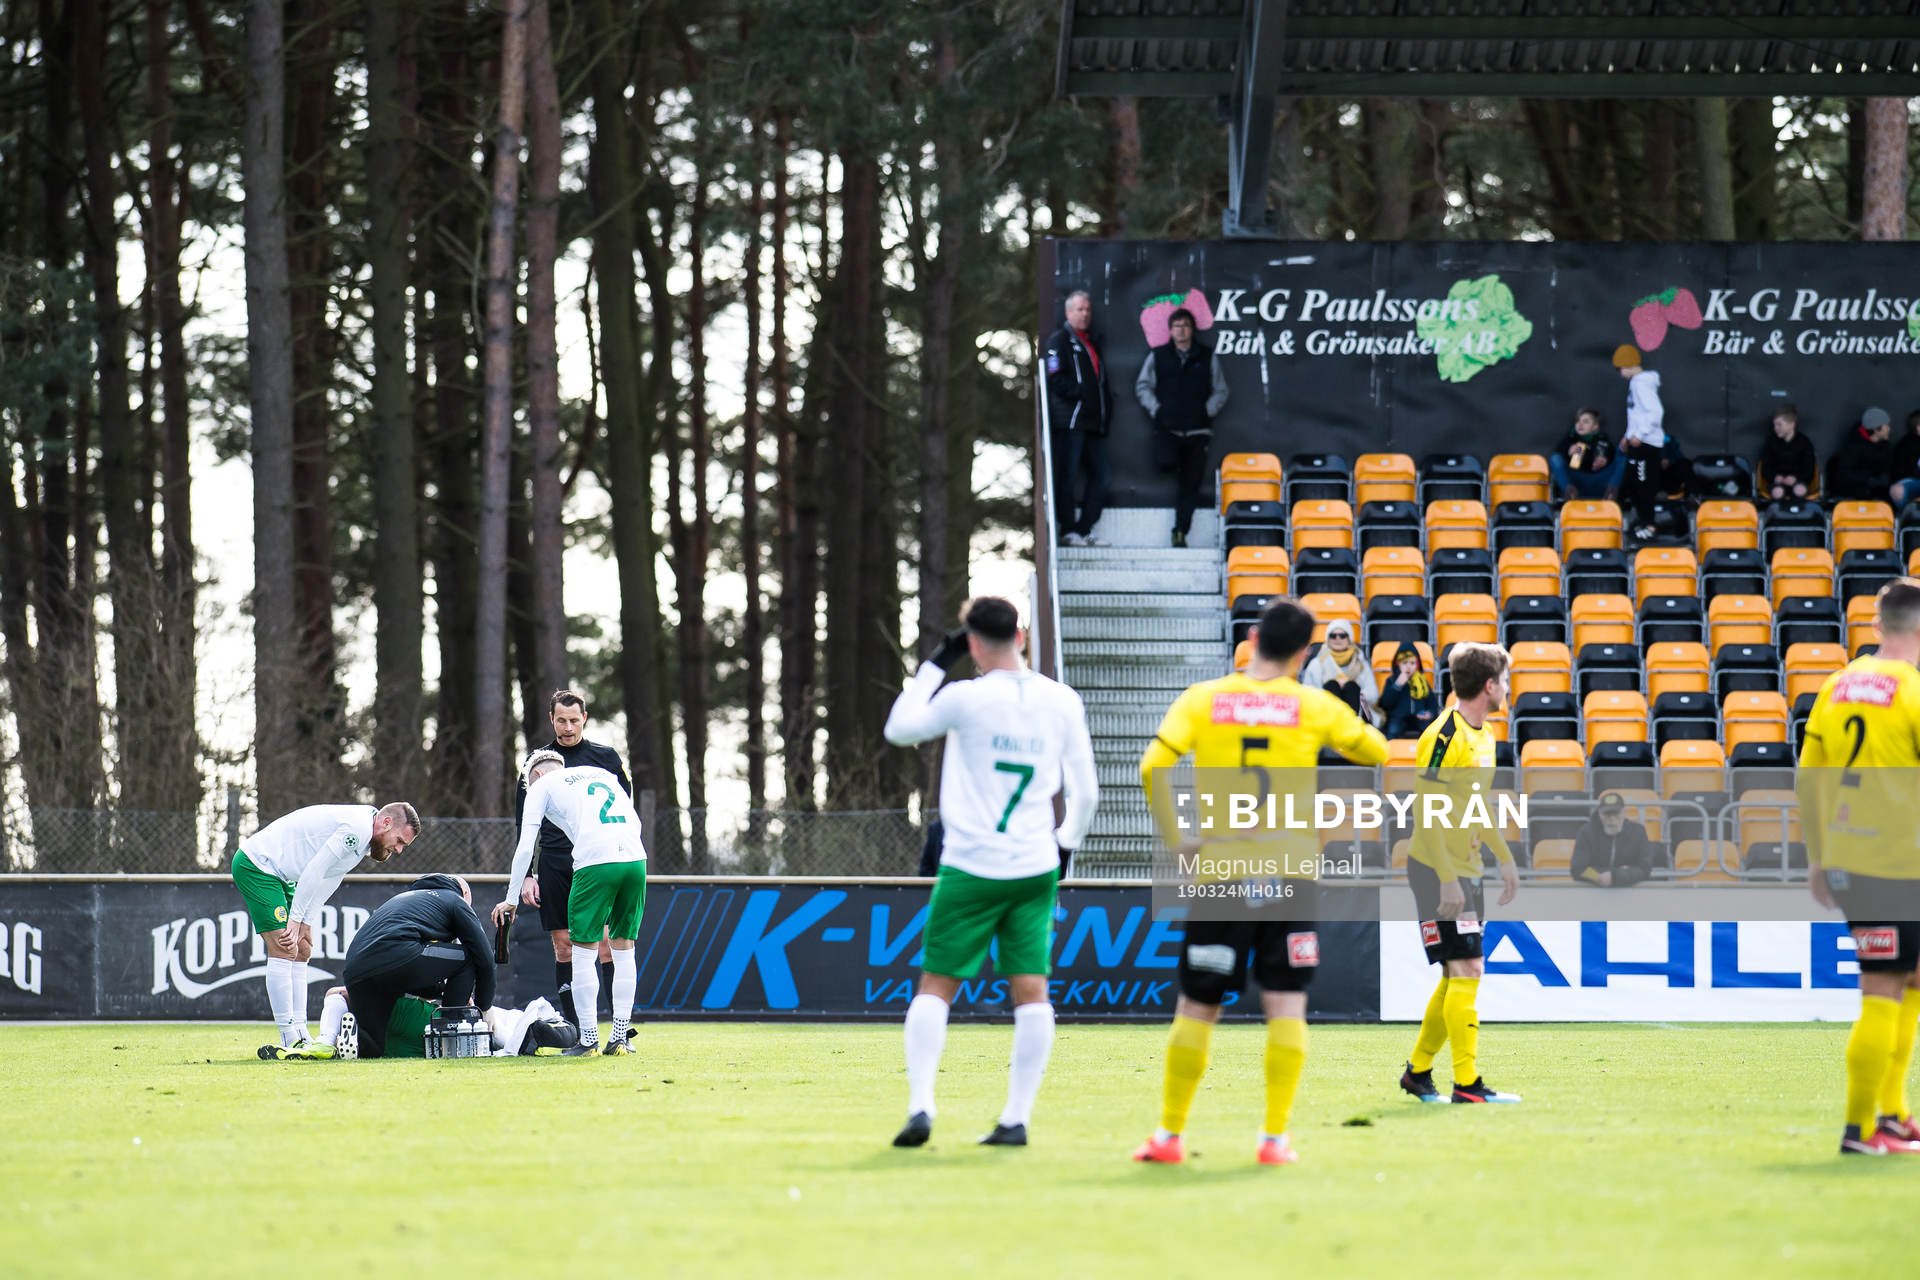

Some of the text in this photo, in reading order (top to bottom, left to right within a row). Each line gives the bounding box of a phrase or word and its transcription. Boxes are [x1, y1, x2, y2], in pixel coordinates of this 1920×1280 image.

[1214, 288, 1480, 322] K-G Paulssons
[1703, 288, 1781, 322] K-G
[1215, 329, 1499, 356] Bär & Grönsaker AB
[1703, 329, 1756, 355] Bär
[1762, 329, 1786, 355] &
[1840, 714, 1866, 788] 2
[1241, 736, 1271, 812] 5
[587, 781, 626, 825] 2
[995, 761, 1034, 833] 7
[864, 978, 1173, 1005] VANSEKNIK
